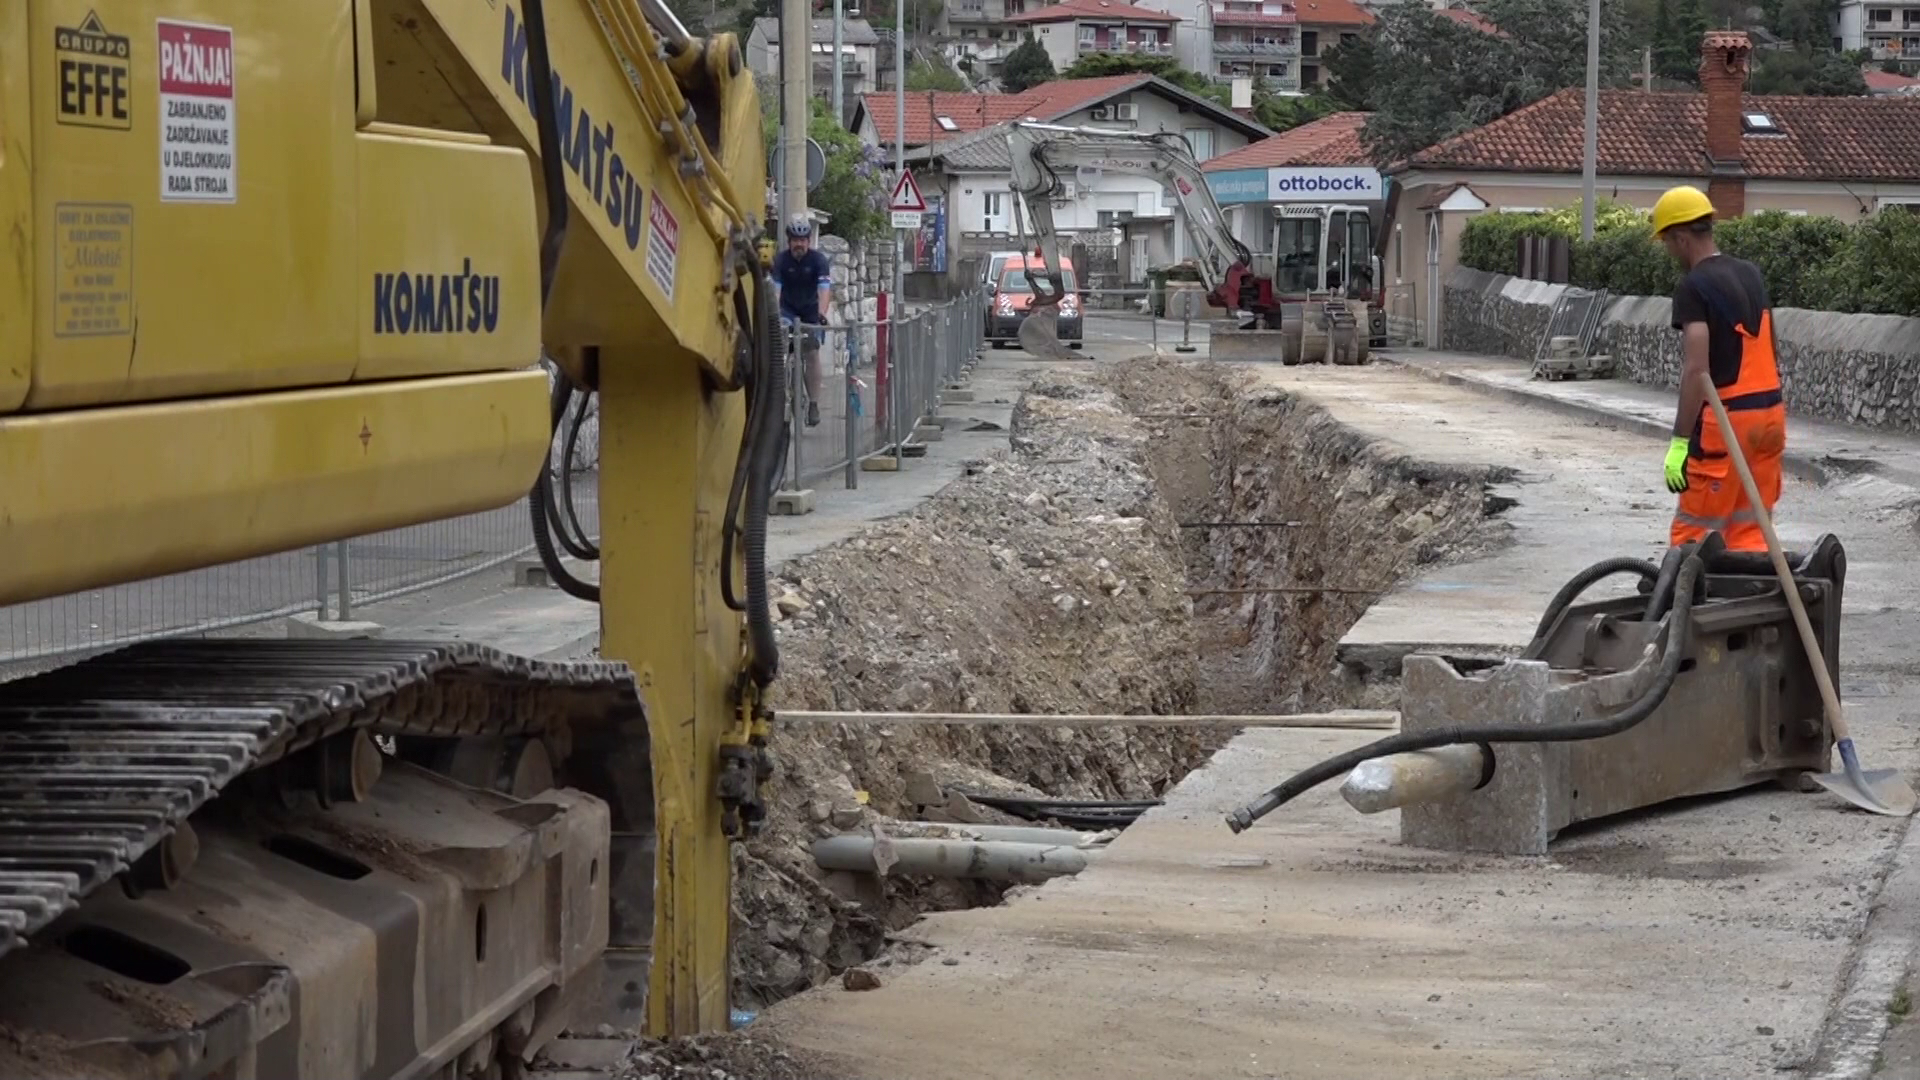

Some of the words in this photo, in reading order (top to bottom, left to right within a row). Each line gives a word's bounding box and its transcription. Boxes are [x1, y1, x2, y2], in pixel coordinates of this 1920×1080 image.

[59, 33, 127, 55] GRUPPO
[161, 33, 232, 86] PAŽNJA!
[60, 60, 127, 120] EFFE
[167, 100, 227, 121] ZABRANJENO
[166, 123, 229, 146] ZADRŽAVANJE
[164, 151, 171, 167] U
[173, 151, 231, 170] DJELOKRUGU
[168, 175, 192, 192] RADA
[194, 176, 228, 193] STROJA
[1279, 175, 1371, 191] ottobock.
[374, 257, 499, 334] KOMATSU
